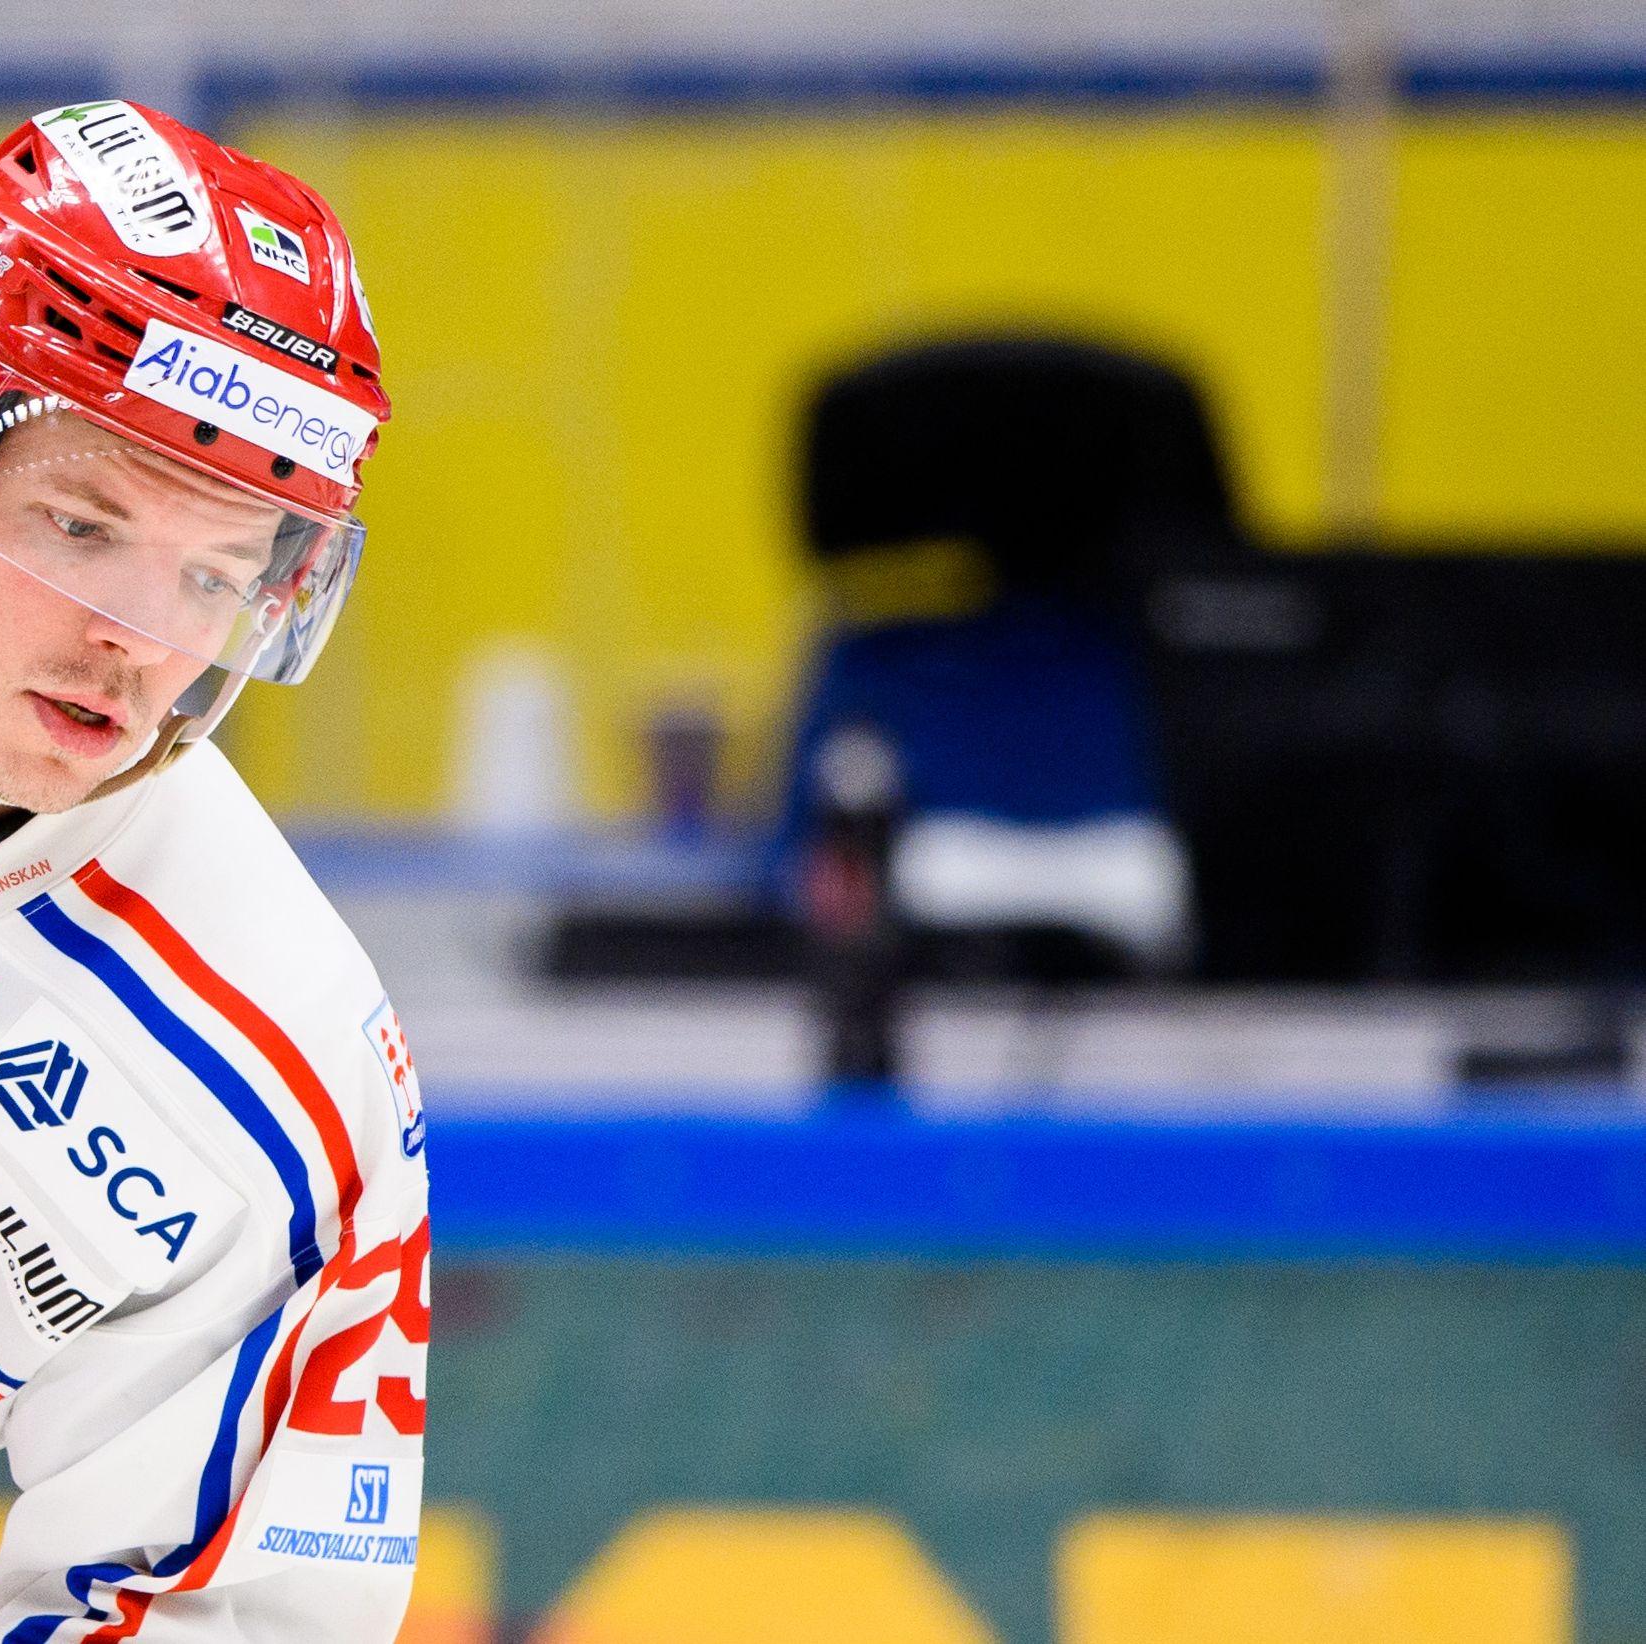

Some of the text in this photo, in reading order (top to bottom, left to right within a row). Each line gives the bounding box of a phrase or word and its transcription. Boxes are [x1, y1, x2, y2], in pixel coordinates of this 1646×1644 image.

[254, 243, 307, 275] NHC
[223, 310, 337, 370] BAUER
[67, 1126, 198, 1263] SCA
[349, 1468, 387, 1521] ST
[258, 1526, 418, 1565] SUNDSVALLS TIDNI
